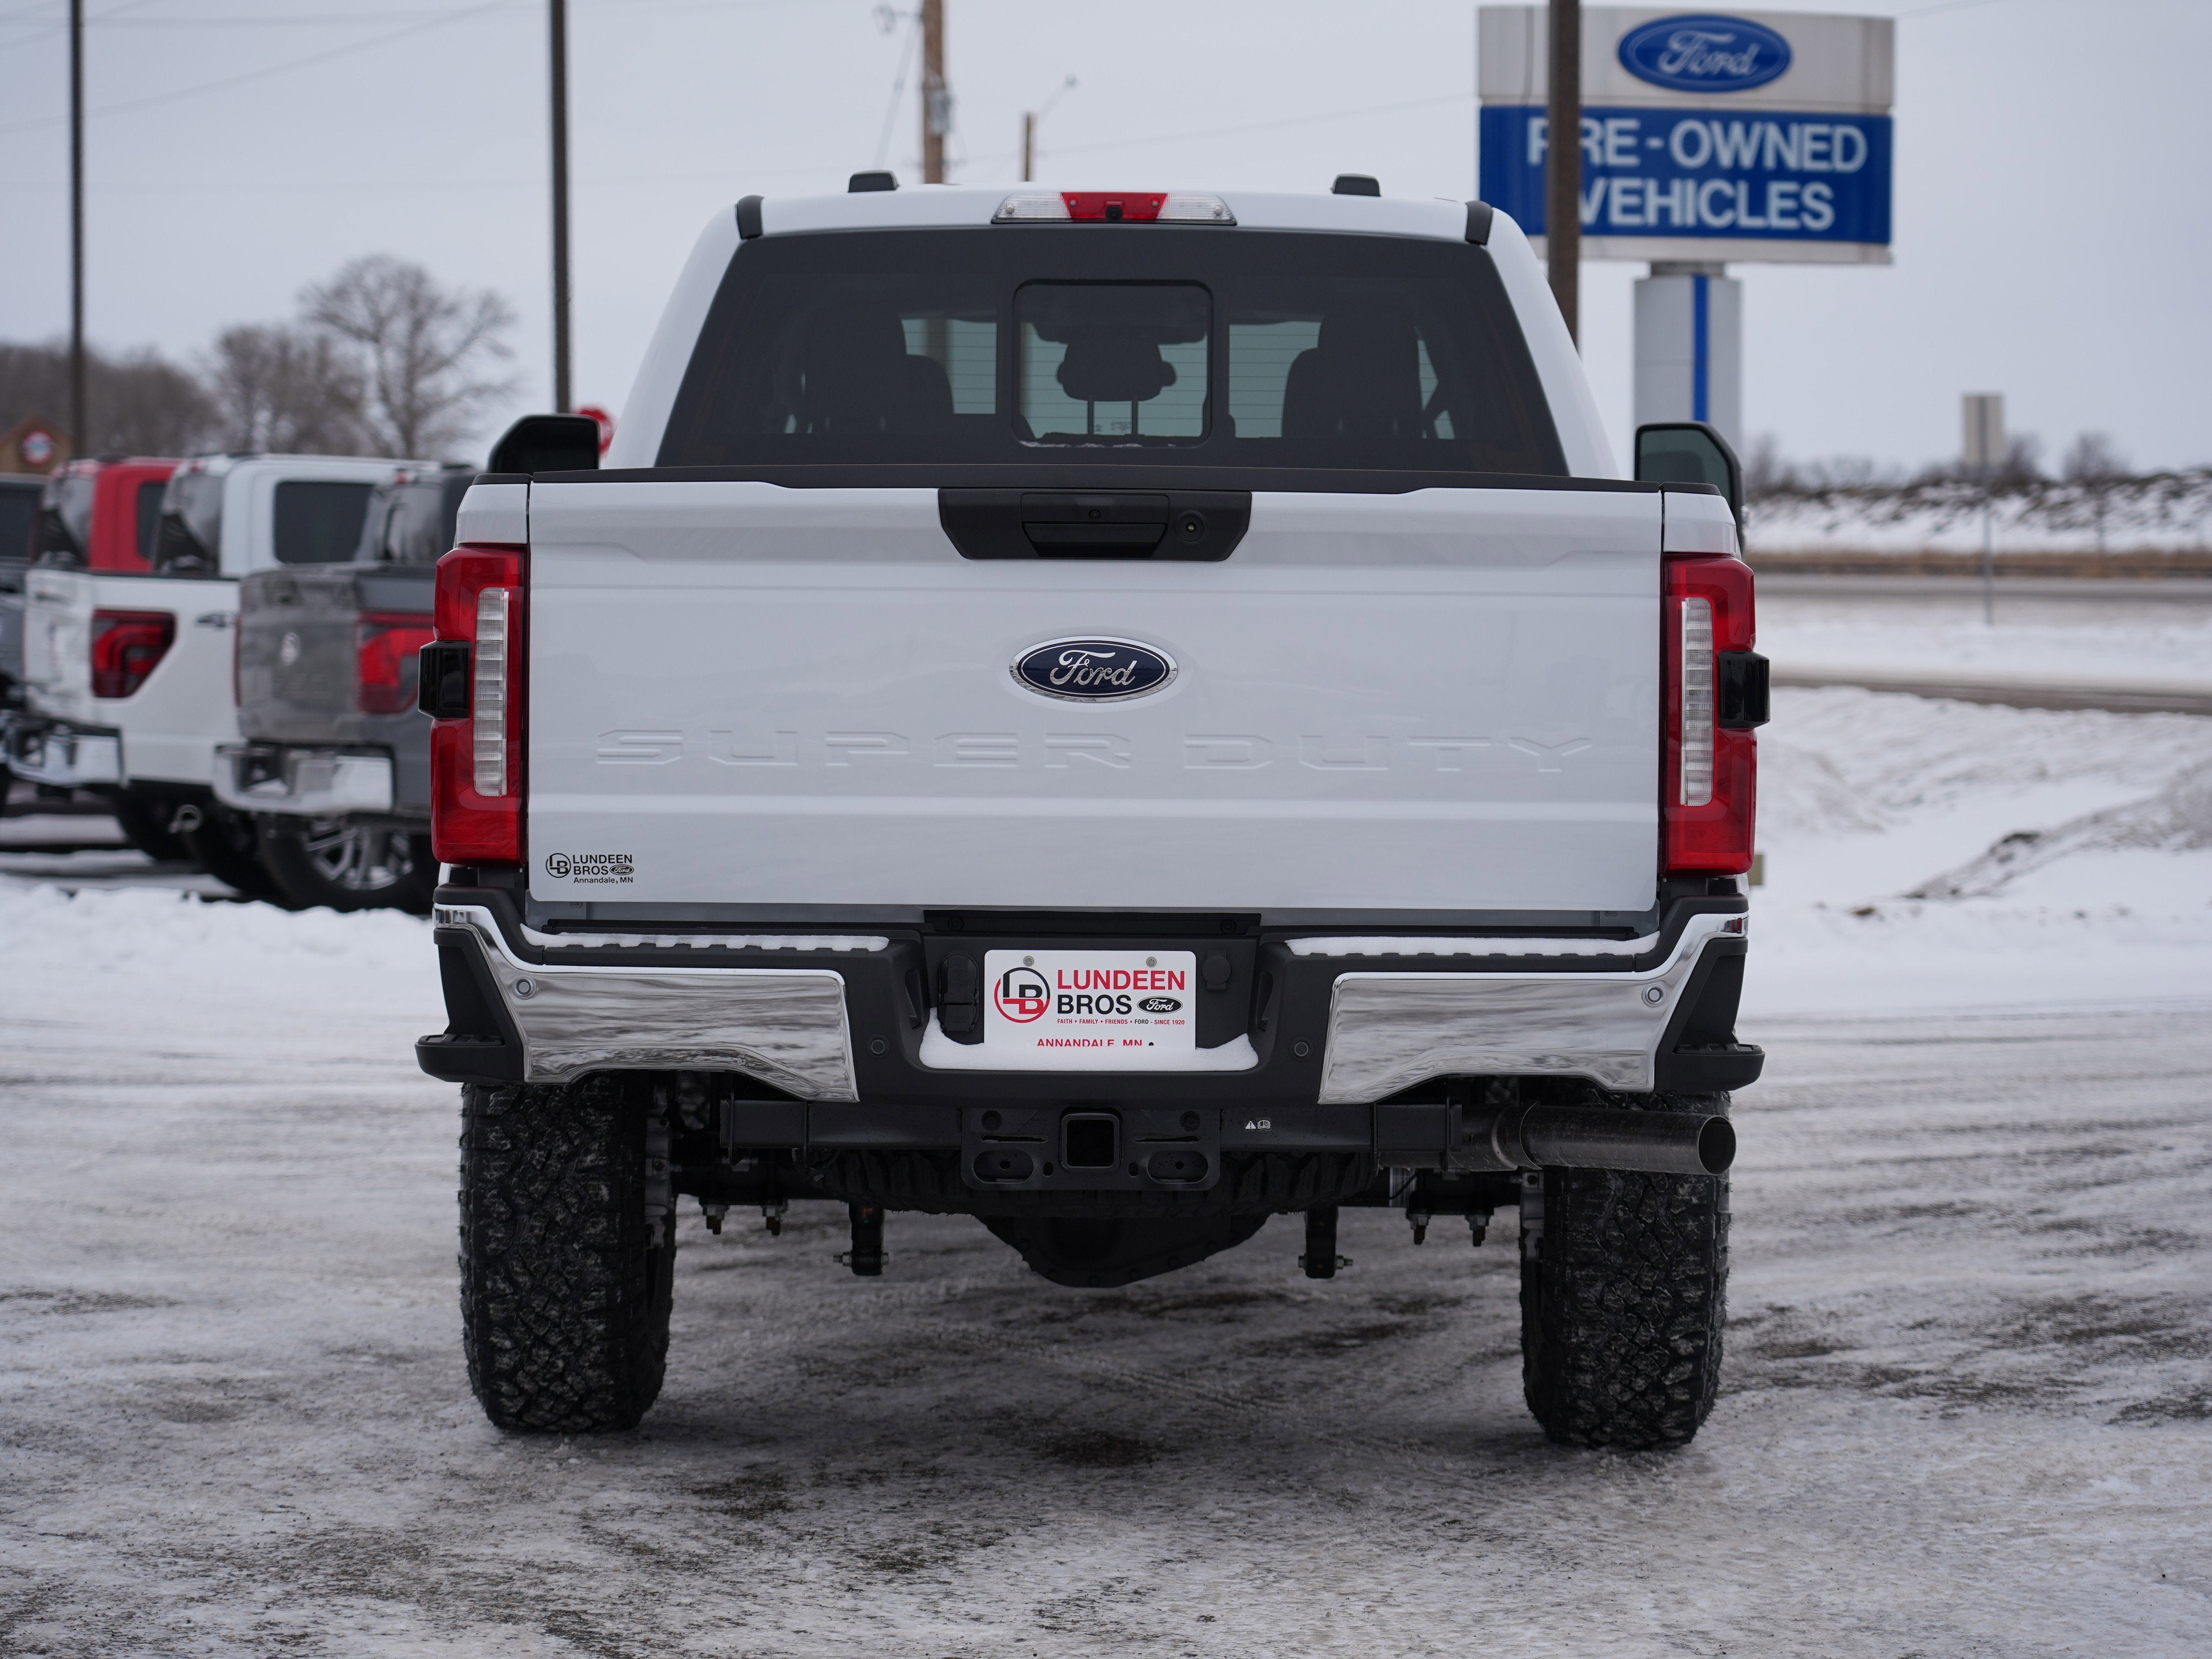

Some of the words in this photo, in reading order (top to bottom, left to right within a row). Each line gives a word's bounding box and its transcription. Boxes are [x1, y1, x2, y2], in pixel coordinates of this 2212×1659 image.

[1658, 29, 1762, 77] Ford
[1580, 178, 1835, 231] VEHICLES
[1049, 650, 1138, 685] Ford
[597, 729, 1131, 768] SUPER
[1183, 733, 1593, 772] DUTY
[572, 854, 632, 864] LUNDEEN
[574, 865, 609, 875] BROS
[613, 866, 631, 874] Ford
[1057, 969, 1185, 990] LUNDEEN
[1057, 994, 1132, 1015] BROS
[1145, 998, 1175, 1011] Ford
